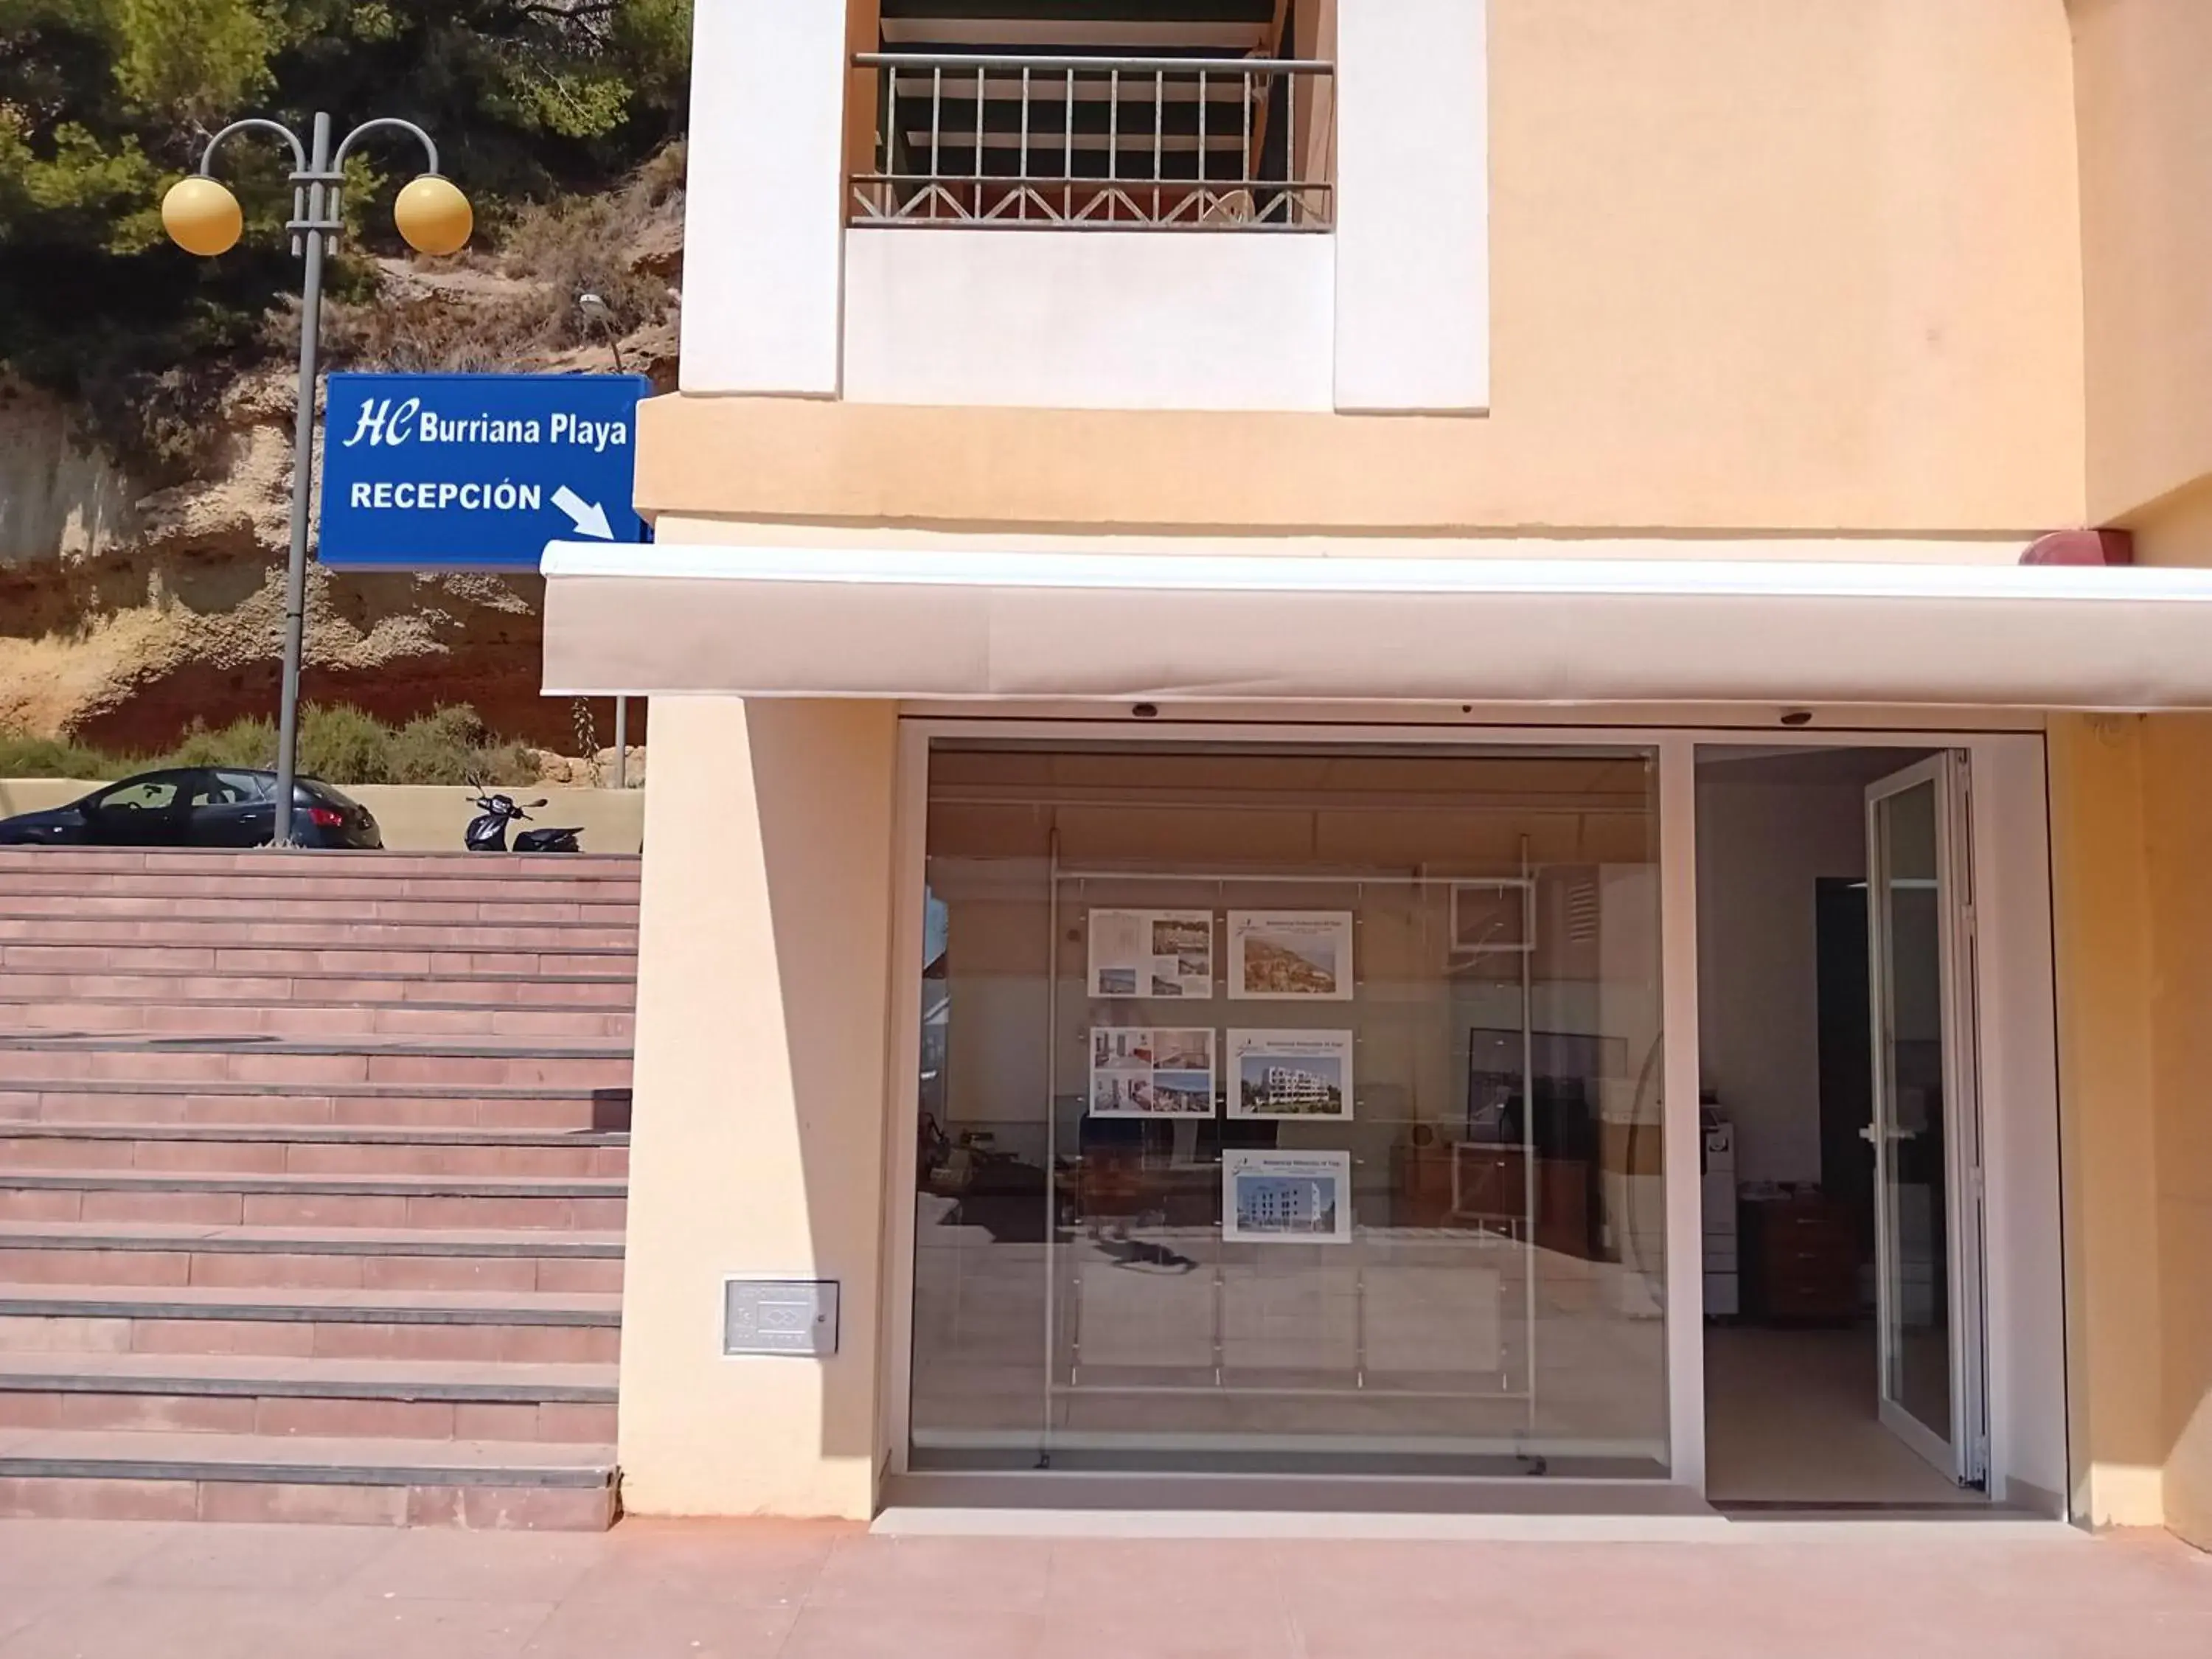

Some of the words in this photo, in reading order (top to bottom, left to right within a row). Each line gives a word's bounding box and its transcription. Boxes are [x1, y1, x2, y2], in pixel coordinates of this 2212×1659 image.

[343, 397, 420, 447] HC
[420, 411, 540, 444] Burriana
[550, 413, 627, 453] Playa
[350, 478, 541, 510] RECEPCIÓN
